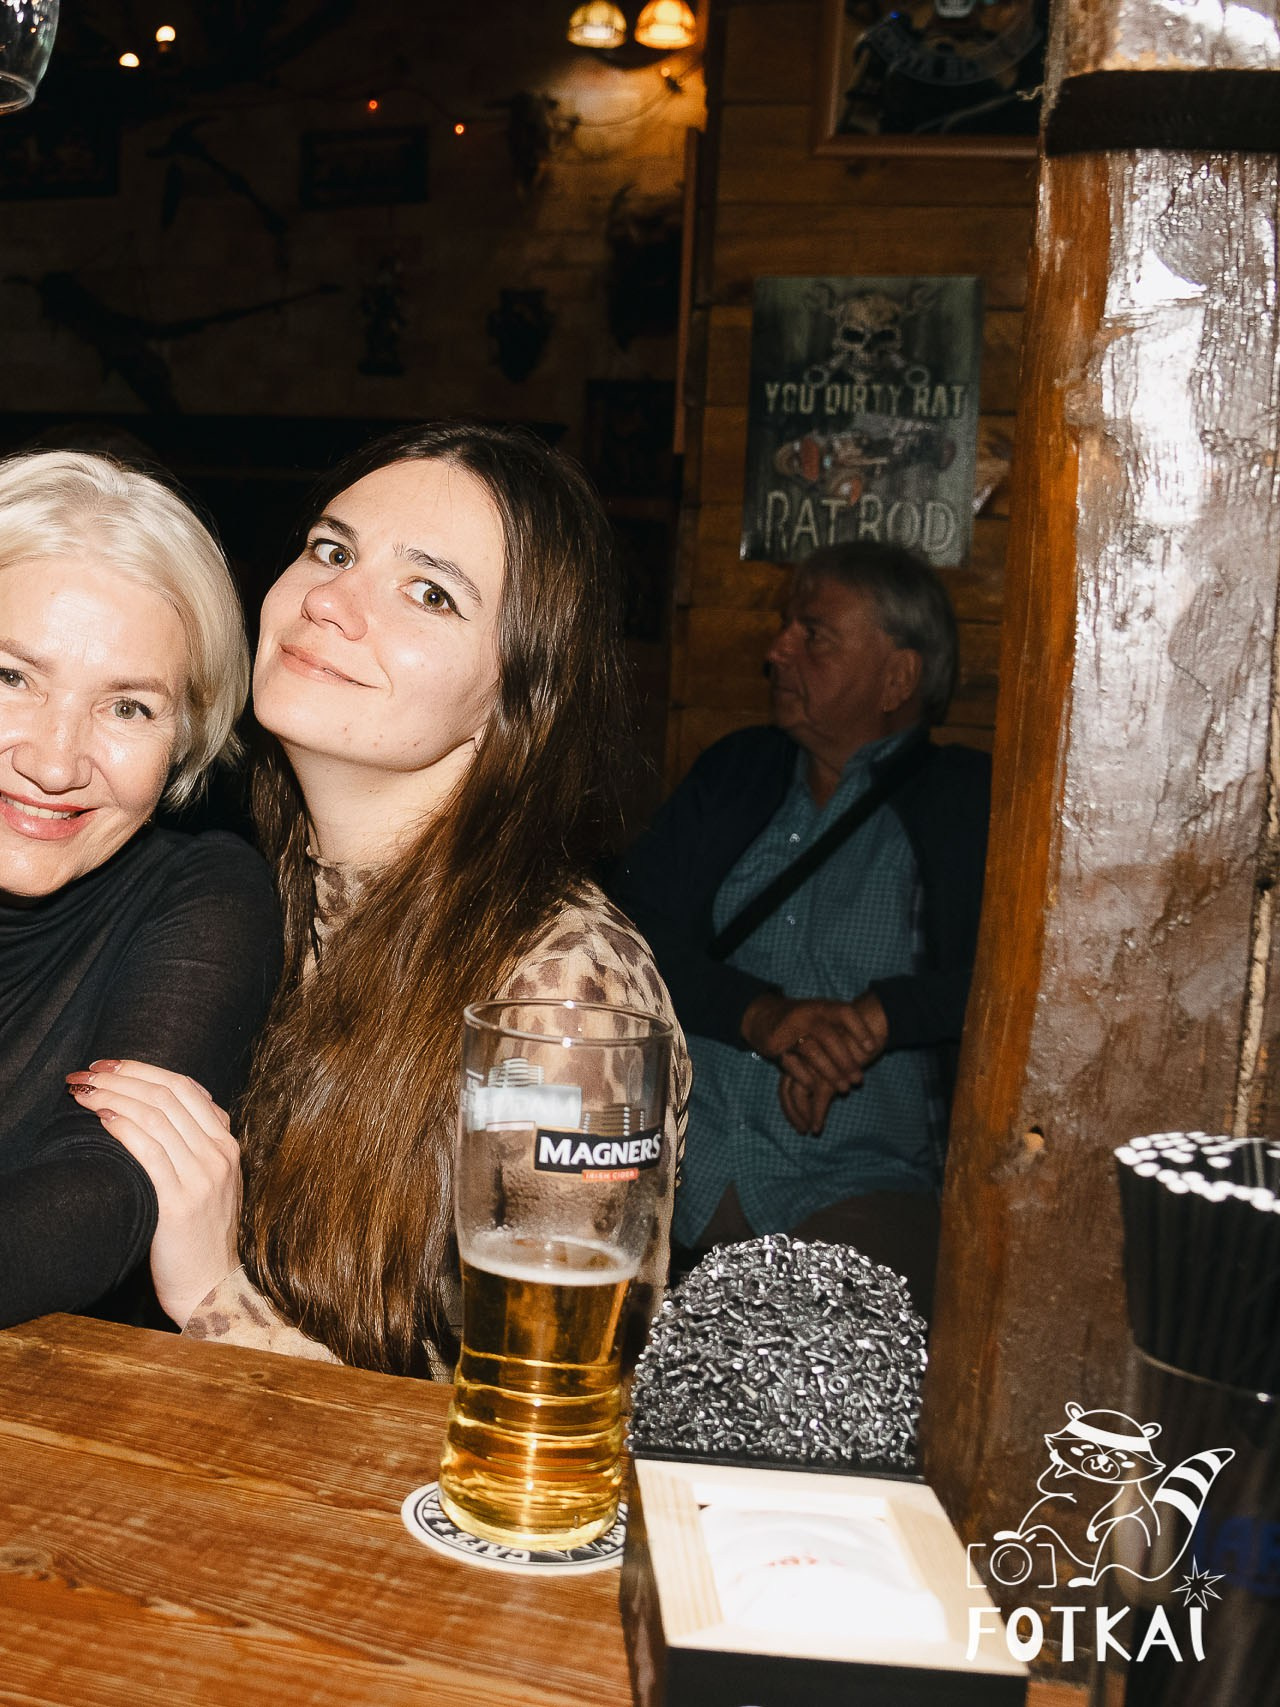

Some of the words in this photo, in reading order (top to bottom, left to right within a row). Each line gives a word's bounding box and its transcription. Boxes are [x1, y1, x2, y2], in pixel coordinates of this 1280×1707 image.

[765, 382, 815, 414] YOU
[824, 383, 904, 416] DIRTY
[912, 384, 965, 418] RAT
[764, 489, 850, 550] RAT
[858, 493, 957, 552] ROD
[538, 1133, 662, 1166] MAGNERS
